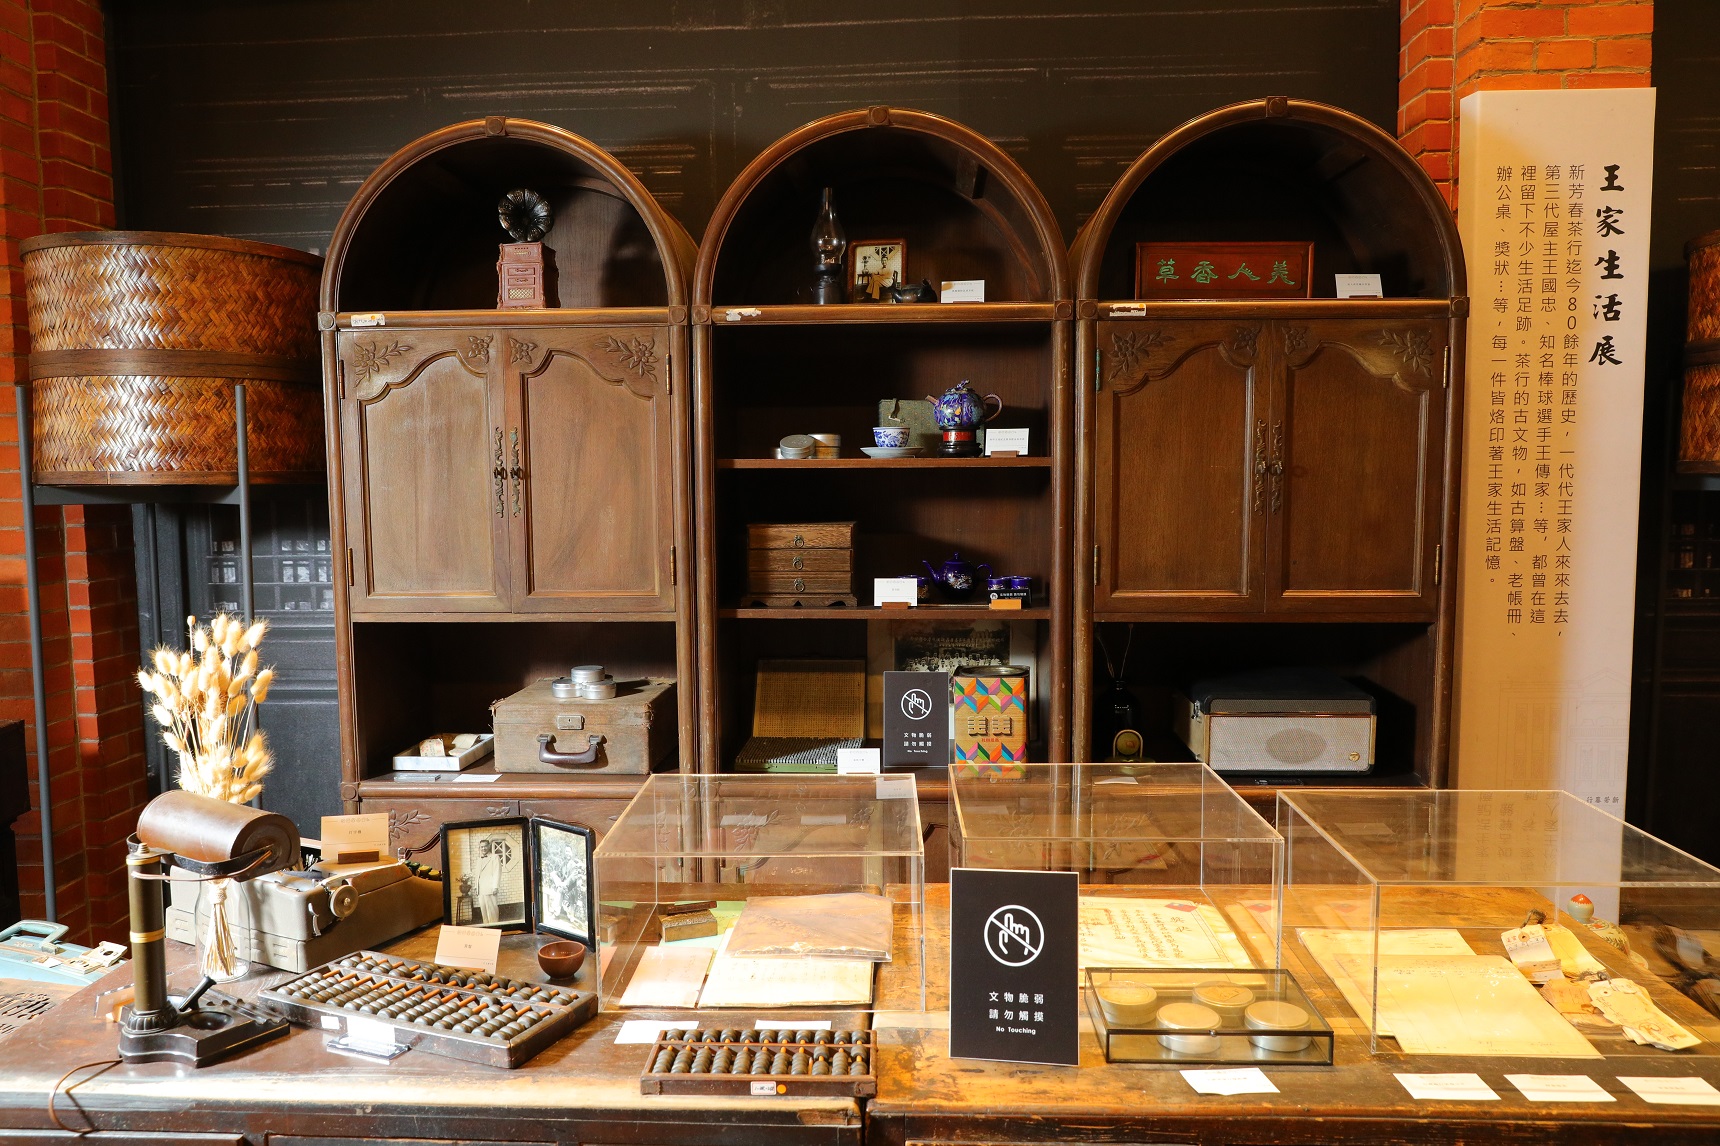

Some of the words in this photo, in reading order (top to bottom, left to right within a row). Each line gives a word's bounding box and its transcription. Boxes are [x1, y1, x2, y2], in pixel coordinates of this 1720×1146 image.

[1588, 163, 1625, 366] 王家生活展
[988, 991, 1044, 1005] 文物脆弱
[988, 1008, 1044, 1023] 請勿觸摸
[1008, 1026, 1036, 1035] Touching
